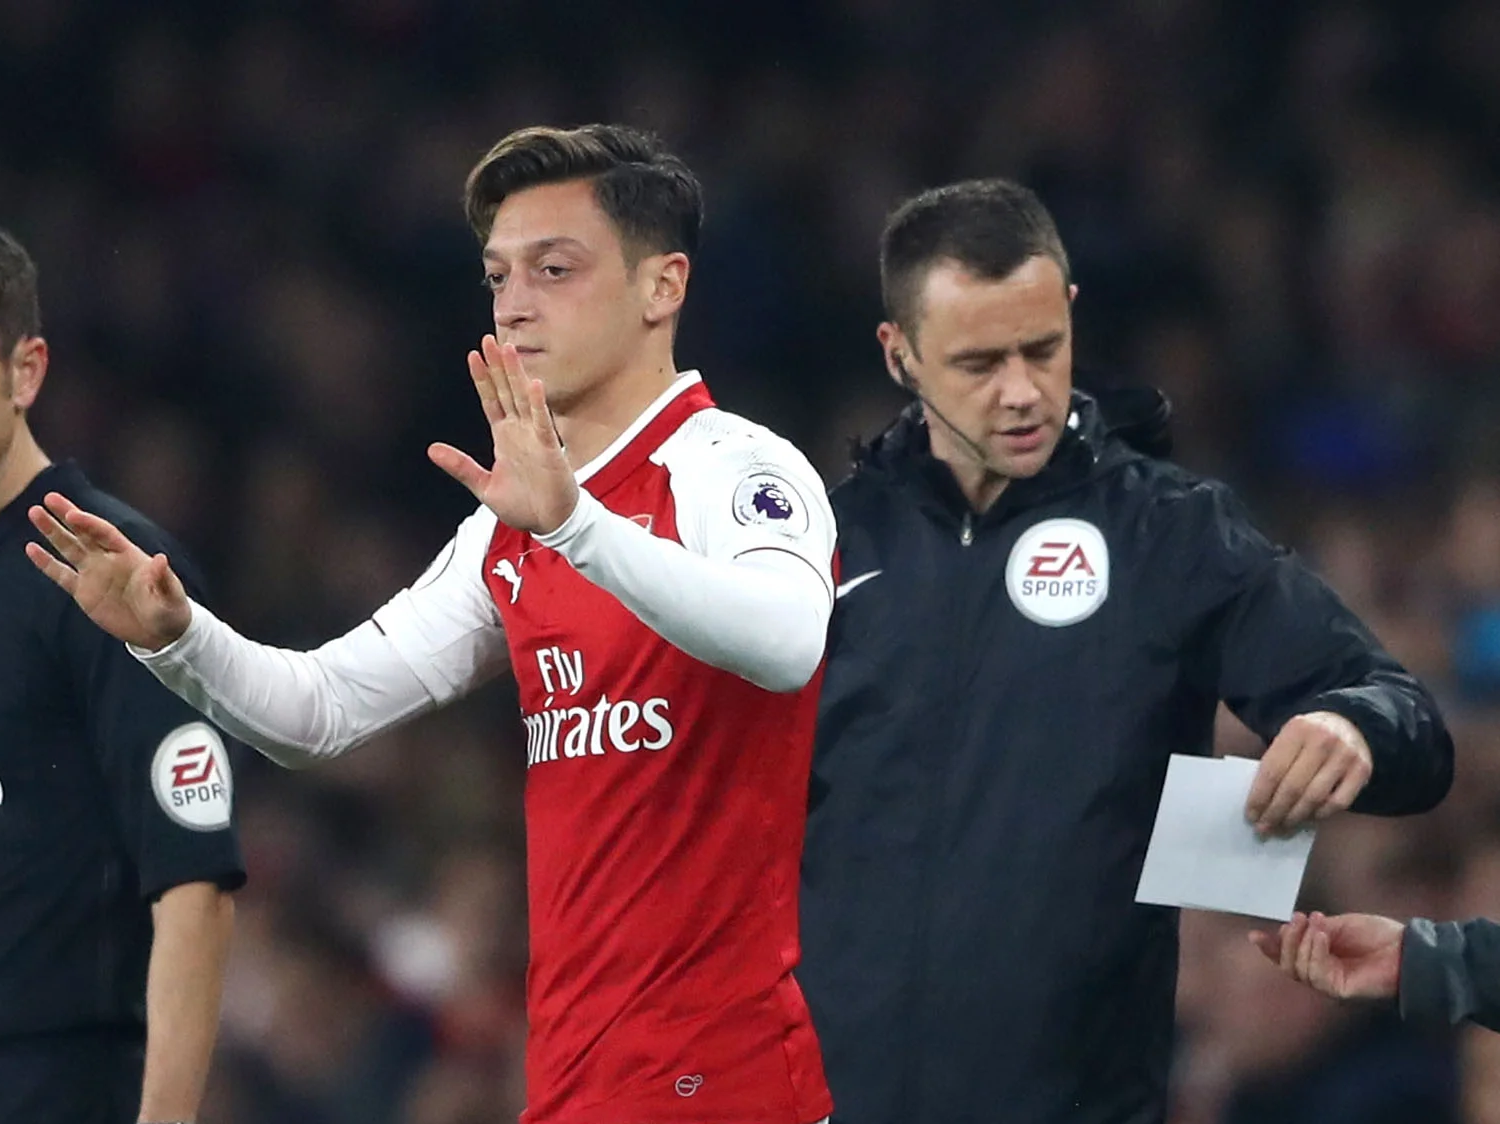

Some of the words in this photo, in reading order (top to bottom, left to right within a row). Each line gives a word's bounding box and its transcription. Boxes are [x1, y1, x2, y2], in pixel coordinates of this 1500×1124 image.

[1026, 542, 1095, 577] EA
[1022, 580, 1097, 597] SPORTS
[536, 646, 583, 696] Fly
[521, 694, 673, 768] mirates
